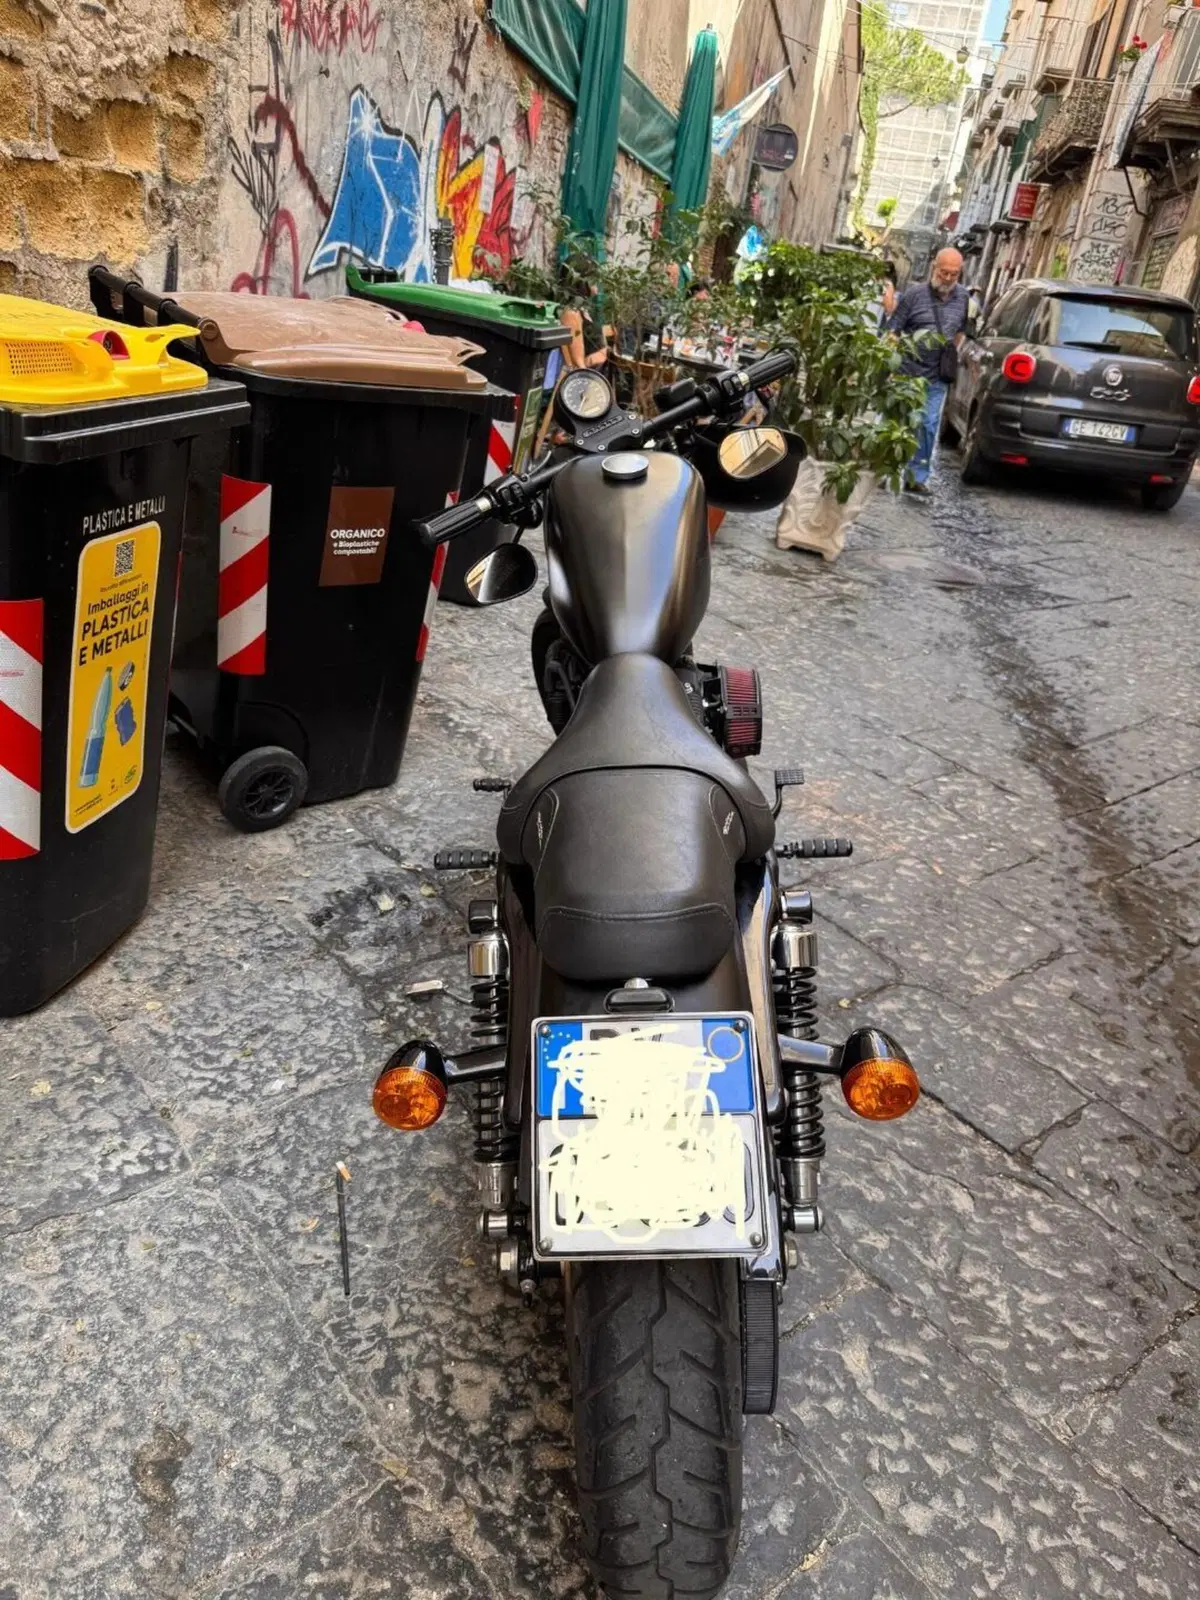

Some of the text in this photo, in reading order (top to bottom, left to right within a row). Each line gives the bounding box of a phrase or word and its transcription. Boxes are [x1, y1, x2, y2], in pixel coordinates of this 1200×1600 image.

[82, 495, 166, 536] PLASTICA E METALLI
[330, 528, 386, 539] ORGANICO
[338, 540, 380, 549] Bioplastiche
[333, 547, 377, 556] compostabili
[87, 585, 140, 616] Imballaggi
[141, 581, 149, 594] in
[81, 597, 150, 642] PLASTICA
[78, 619, 148, 667] E METALLI
